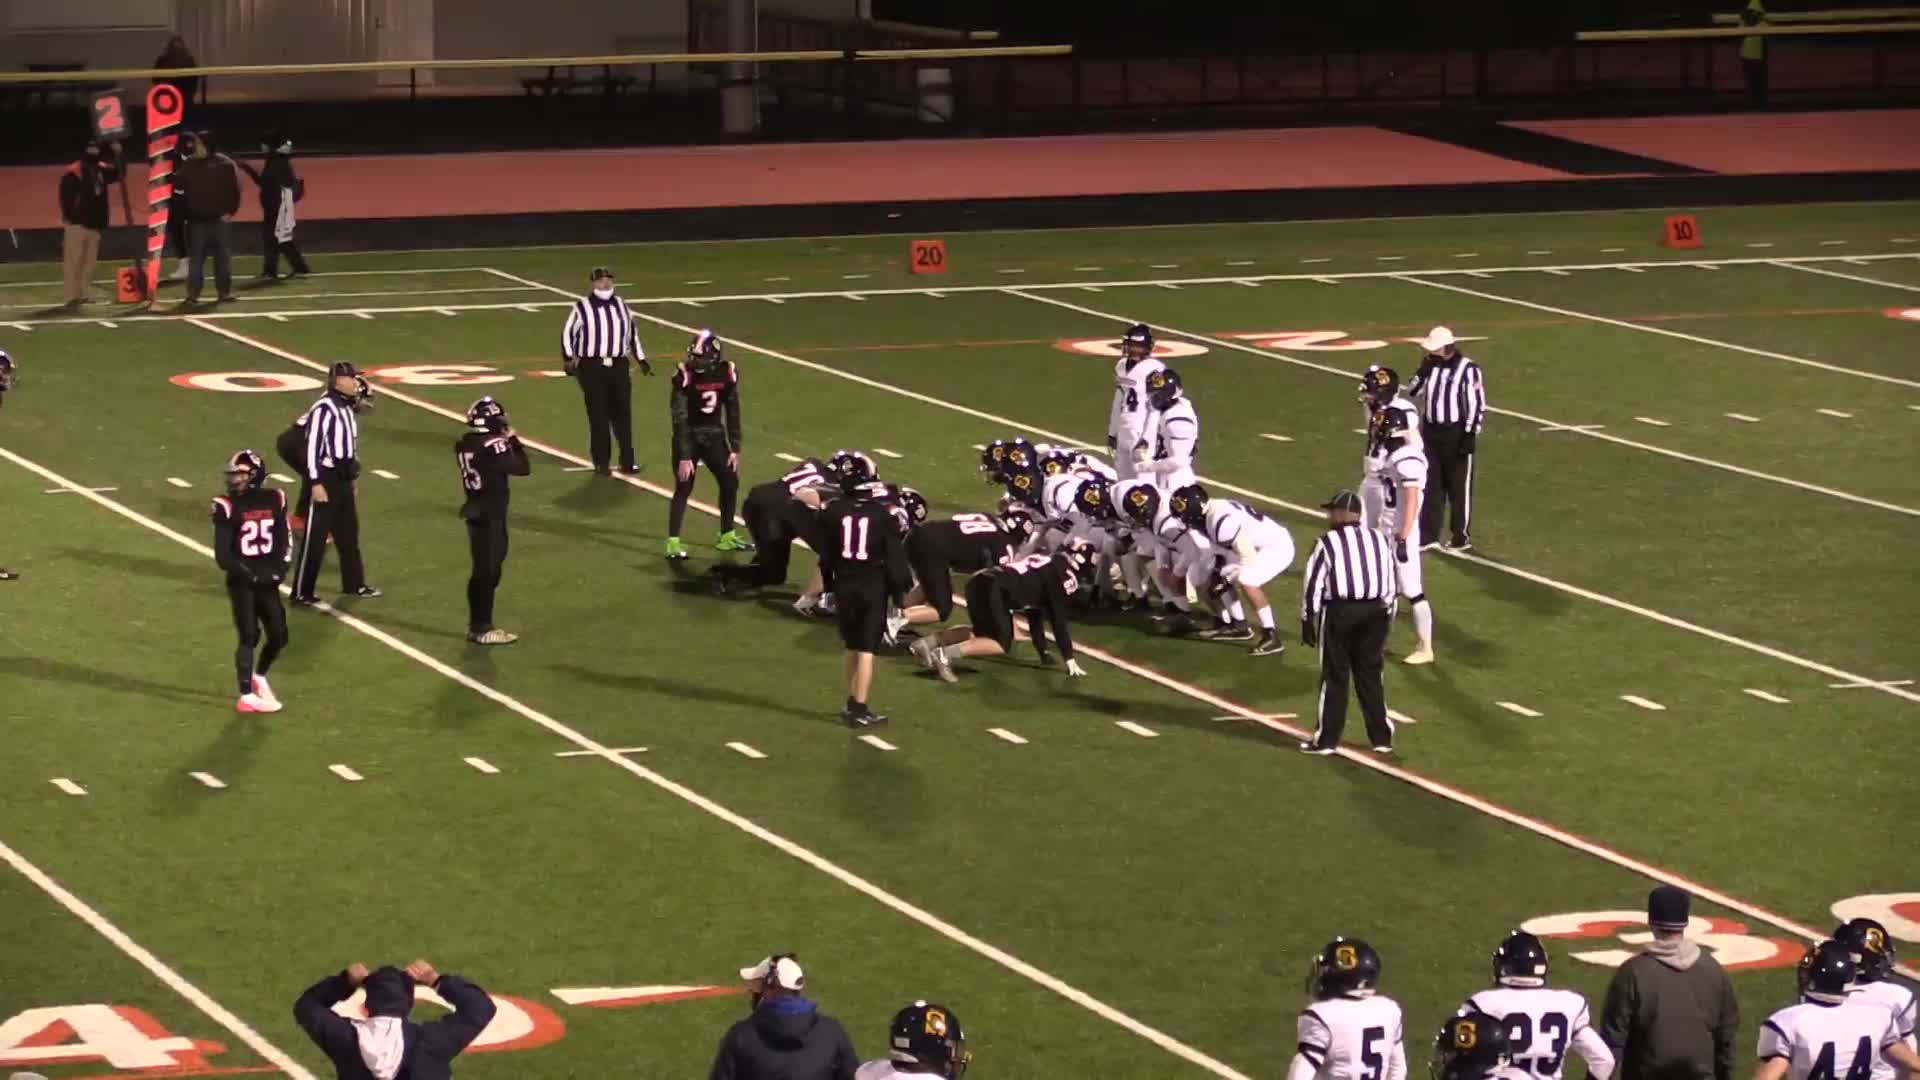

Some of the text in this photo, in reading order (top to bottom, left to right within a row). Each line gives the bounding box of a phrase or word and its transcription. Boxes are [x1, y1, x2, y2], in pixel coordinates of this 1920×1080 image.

[96, 95, 123, 129] 2
[1674, 220, 1693, 240] 10
[917, 246, 942, 266] 20
[701, 391, 717, 413] 3
[459, 452, 481, 490] 15
[241, 519, 274, 556] 25
[841, 515, 869, 560] 11
[1360, 1026, 1385, 1080] 5
[1502, 1012, 1568, 1075] 23
[1808, 1035, 1872, 1080] 44
